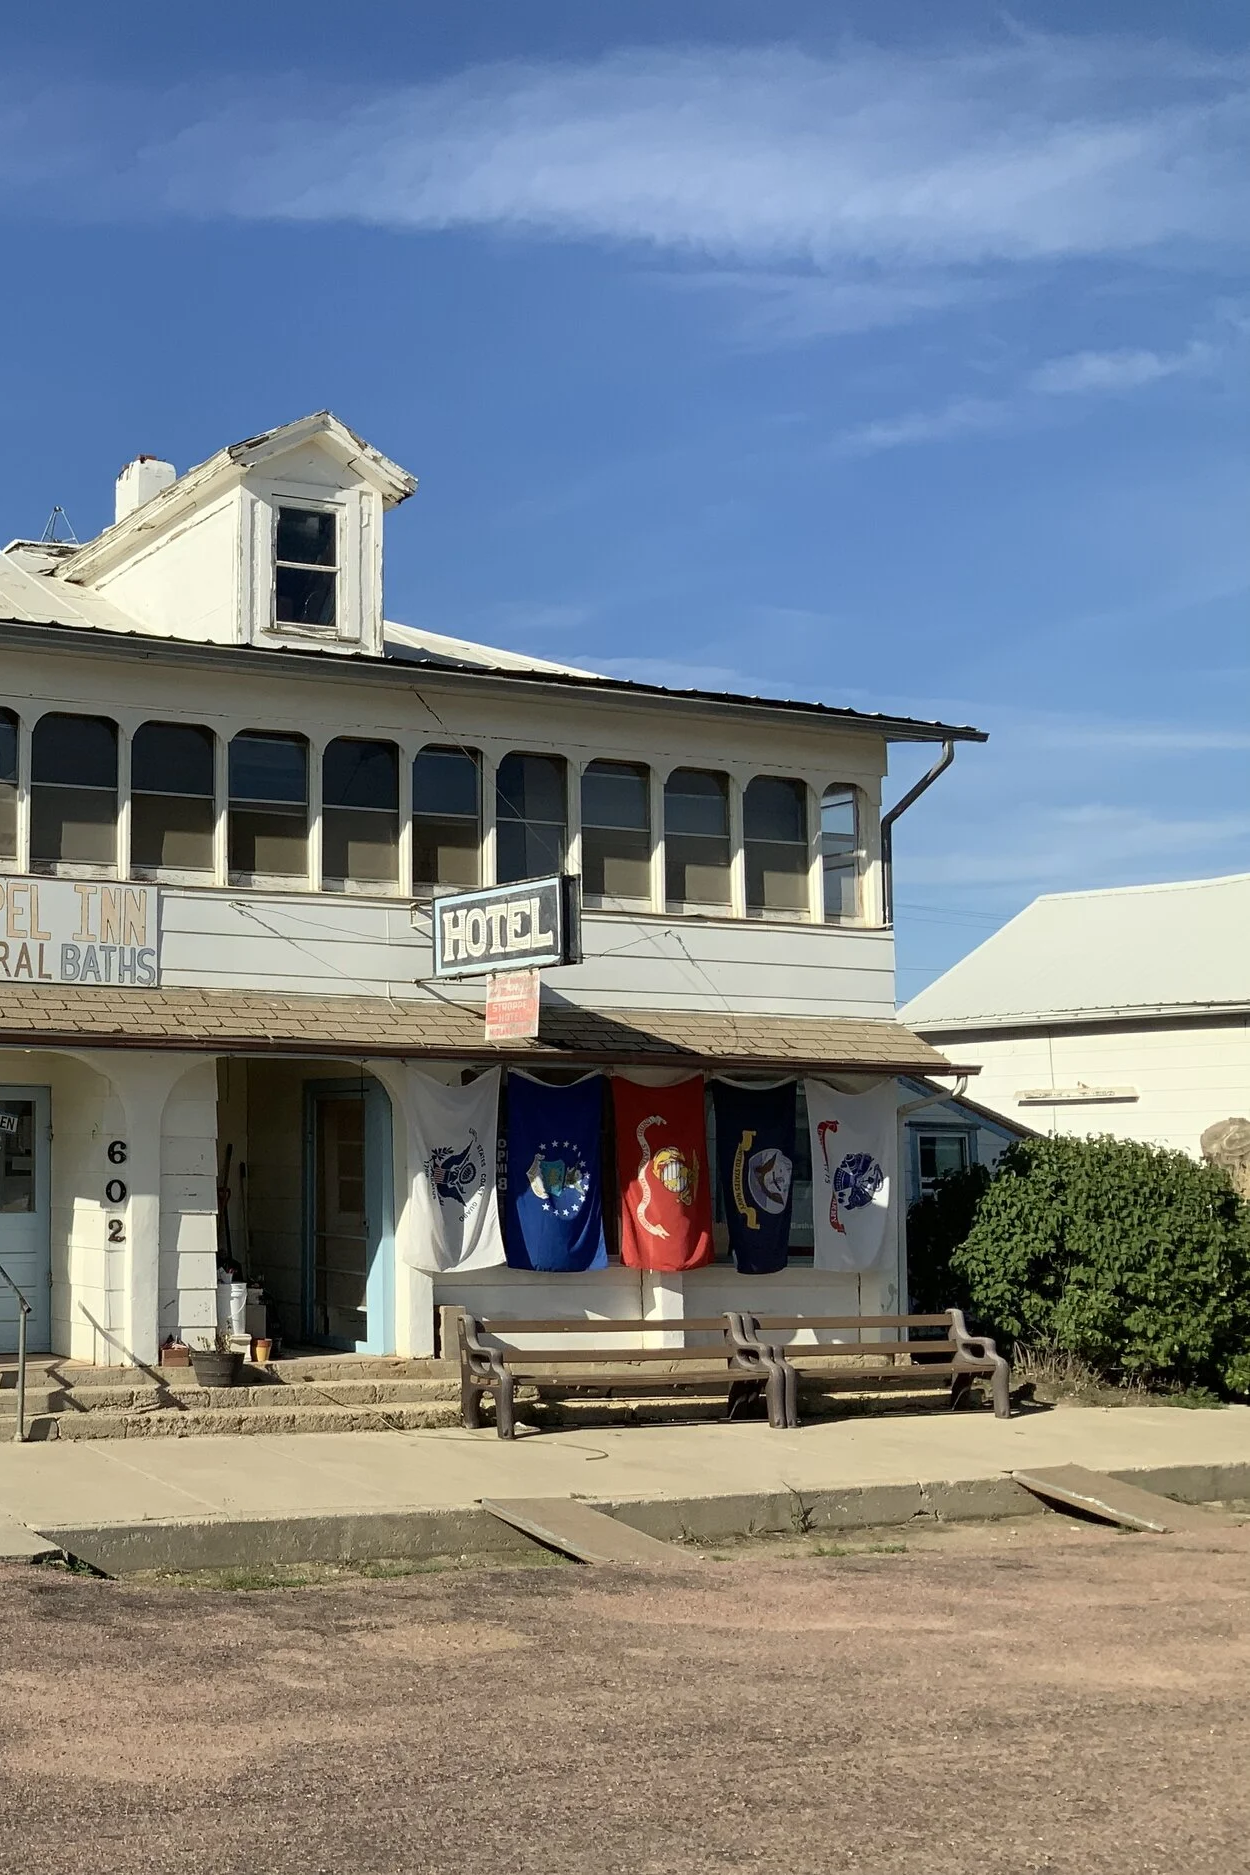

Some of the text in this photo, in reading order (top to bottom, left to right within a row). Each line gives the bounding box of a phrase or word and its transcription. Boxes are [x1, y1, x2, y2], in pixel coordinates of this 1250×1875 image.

[72, 884, 147, 947] INN
[442, 897, 554, 962] HOTEL
[61, 943, 156, 985] BATHS
[105, 1140, 128, 1243] 602
